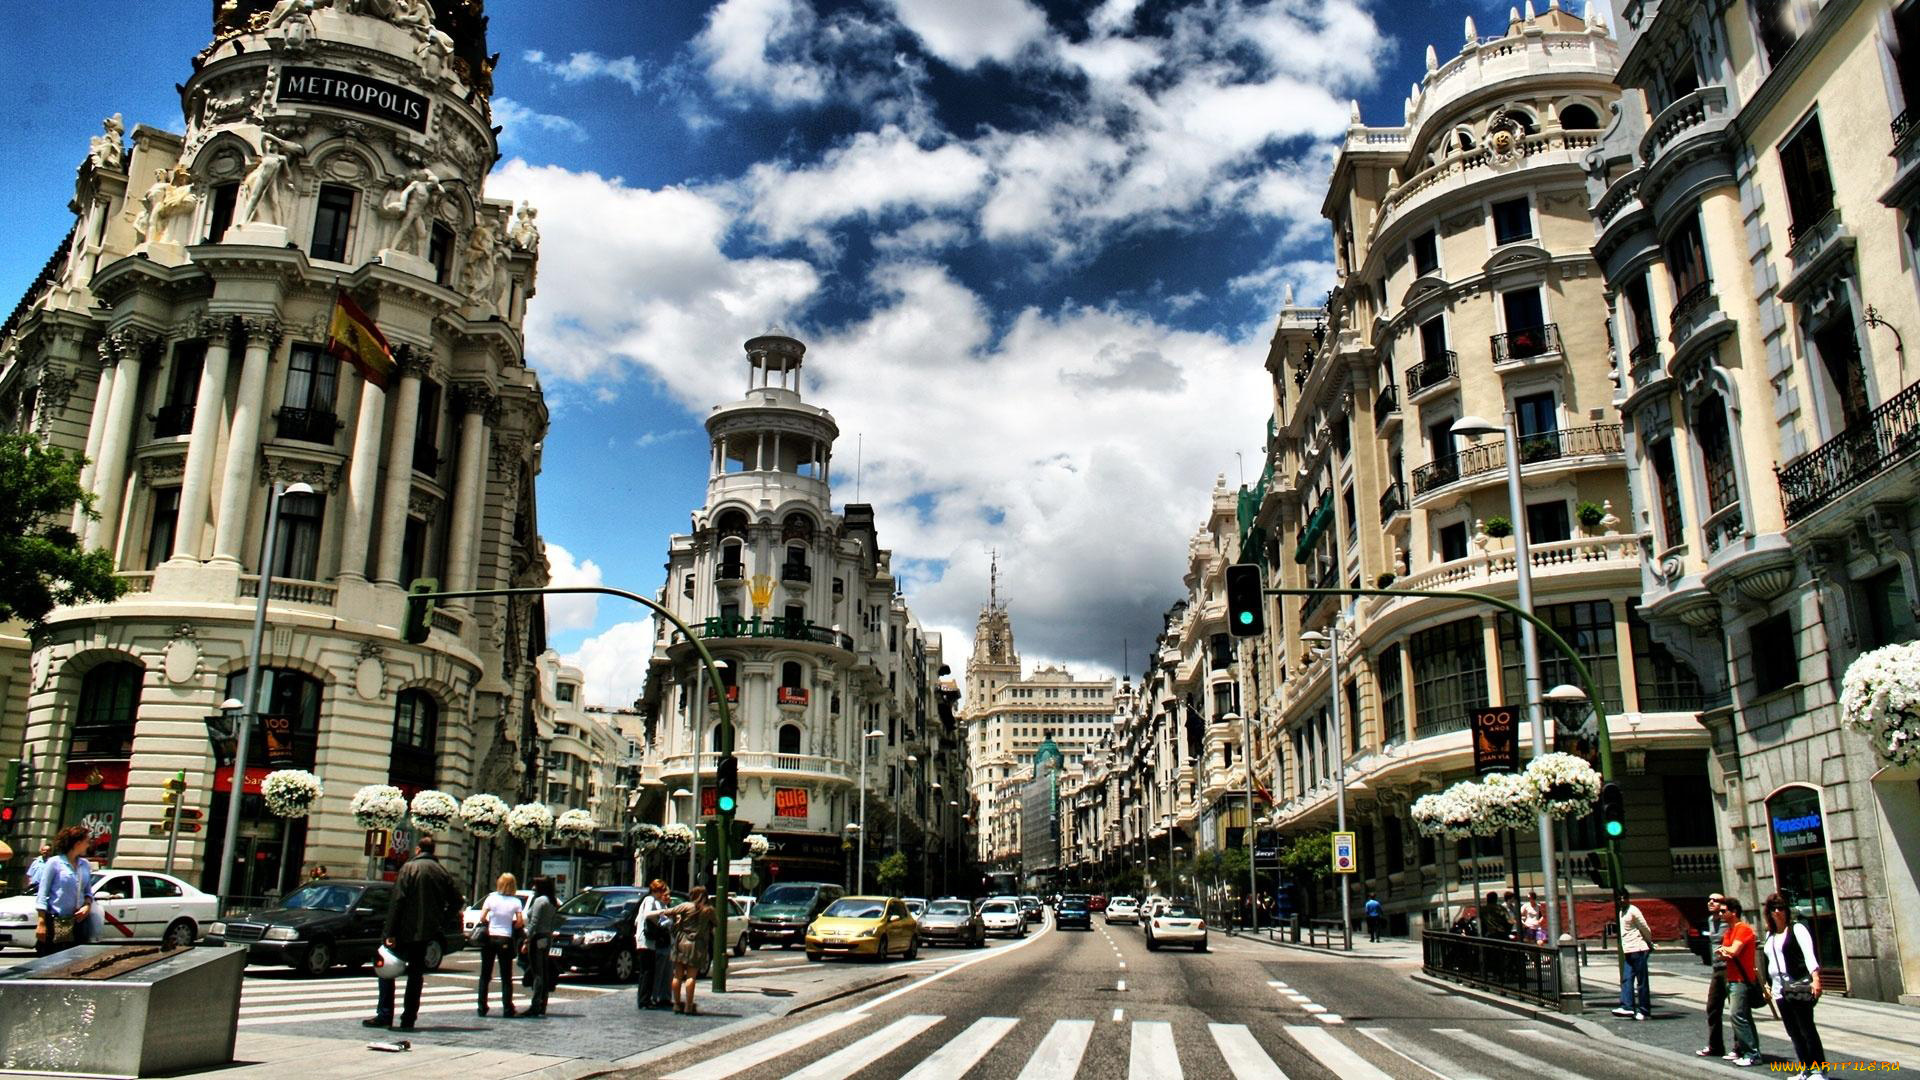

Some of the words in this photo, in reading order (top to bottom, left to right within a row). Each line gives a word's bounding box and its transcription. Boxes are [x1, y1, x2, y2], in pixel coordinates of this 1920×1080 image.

[288, 75, 422, 120] METROPOLIS
[704, 615, 816, 641] ROLEX
[265, 718, 289, 728] 100
[1478, 712, 1510, 726] 100
[1772, 810, 1821, 833] Panasonic
